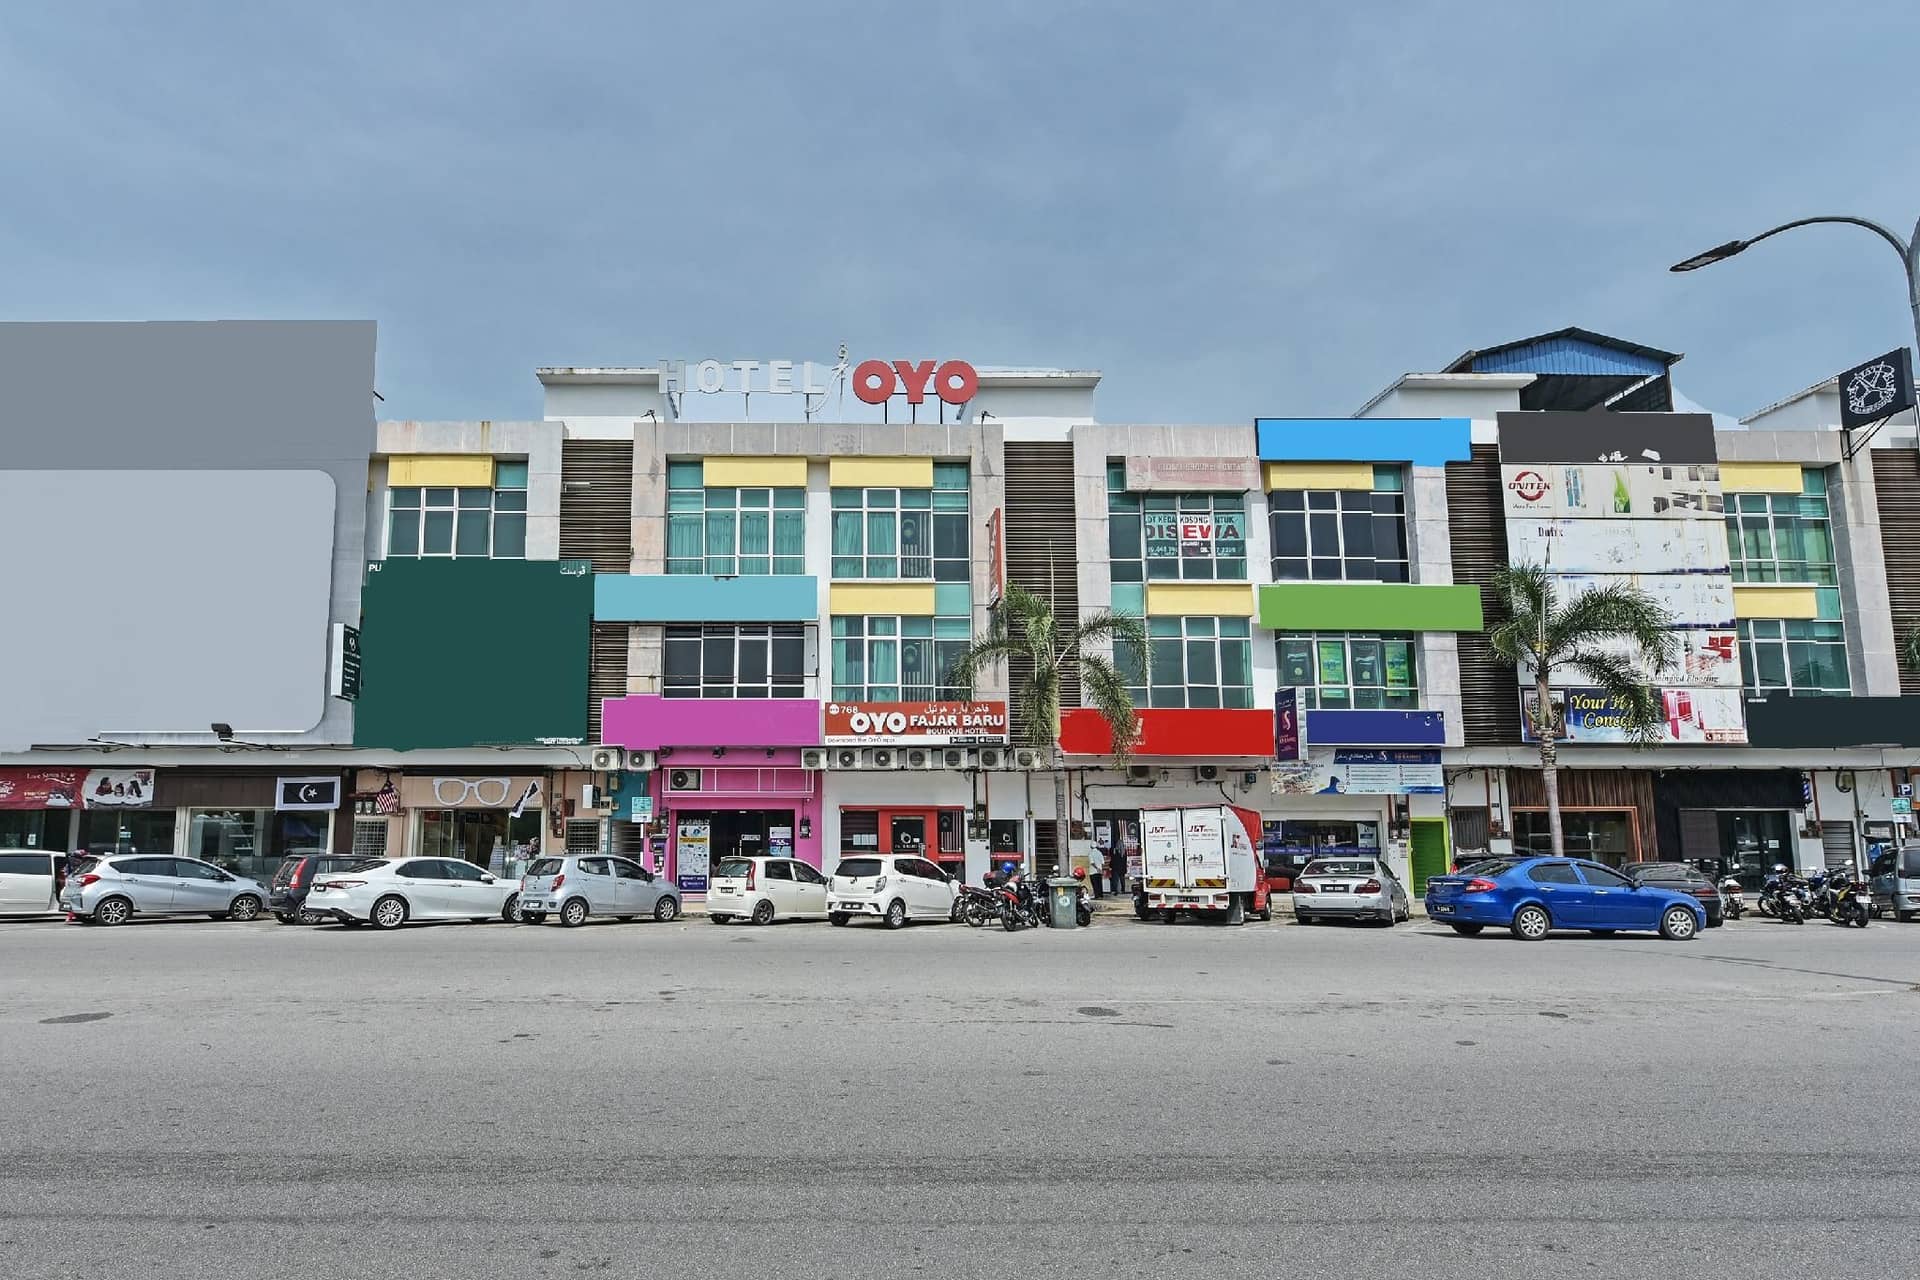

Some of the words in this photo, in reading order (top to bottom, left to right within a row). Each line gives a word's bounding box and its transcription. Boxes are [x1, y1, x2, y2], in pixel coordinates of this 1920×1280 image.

[658, 359, 825, 394] HOTEL
[852, 360, 978, 405] OYO
[1145, 525, 1239, 538] DISEWA
[1570, 694, 1607, 710] Your
[840, 706, 858, 714] 768
[850, 712, 906, 733] OYO
[910, 715, 958, 726] FAJAR
[962, 715, 1004, 726] BARU
[1902, 785, 1910, 794] P
